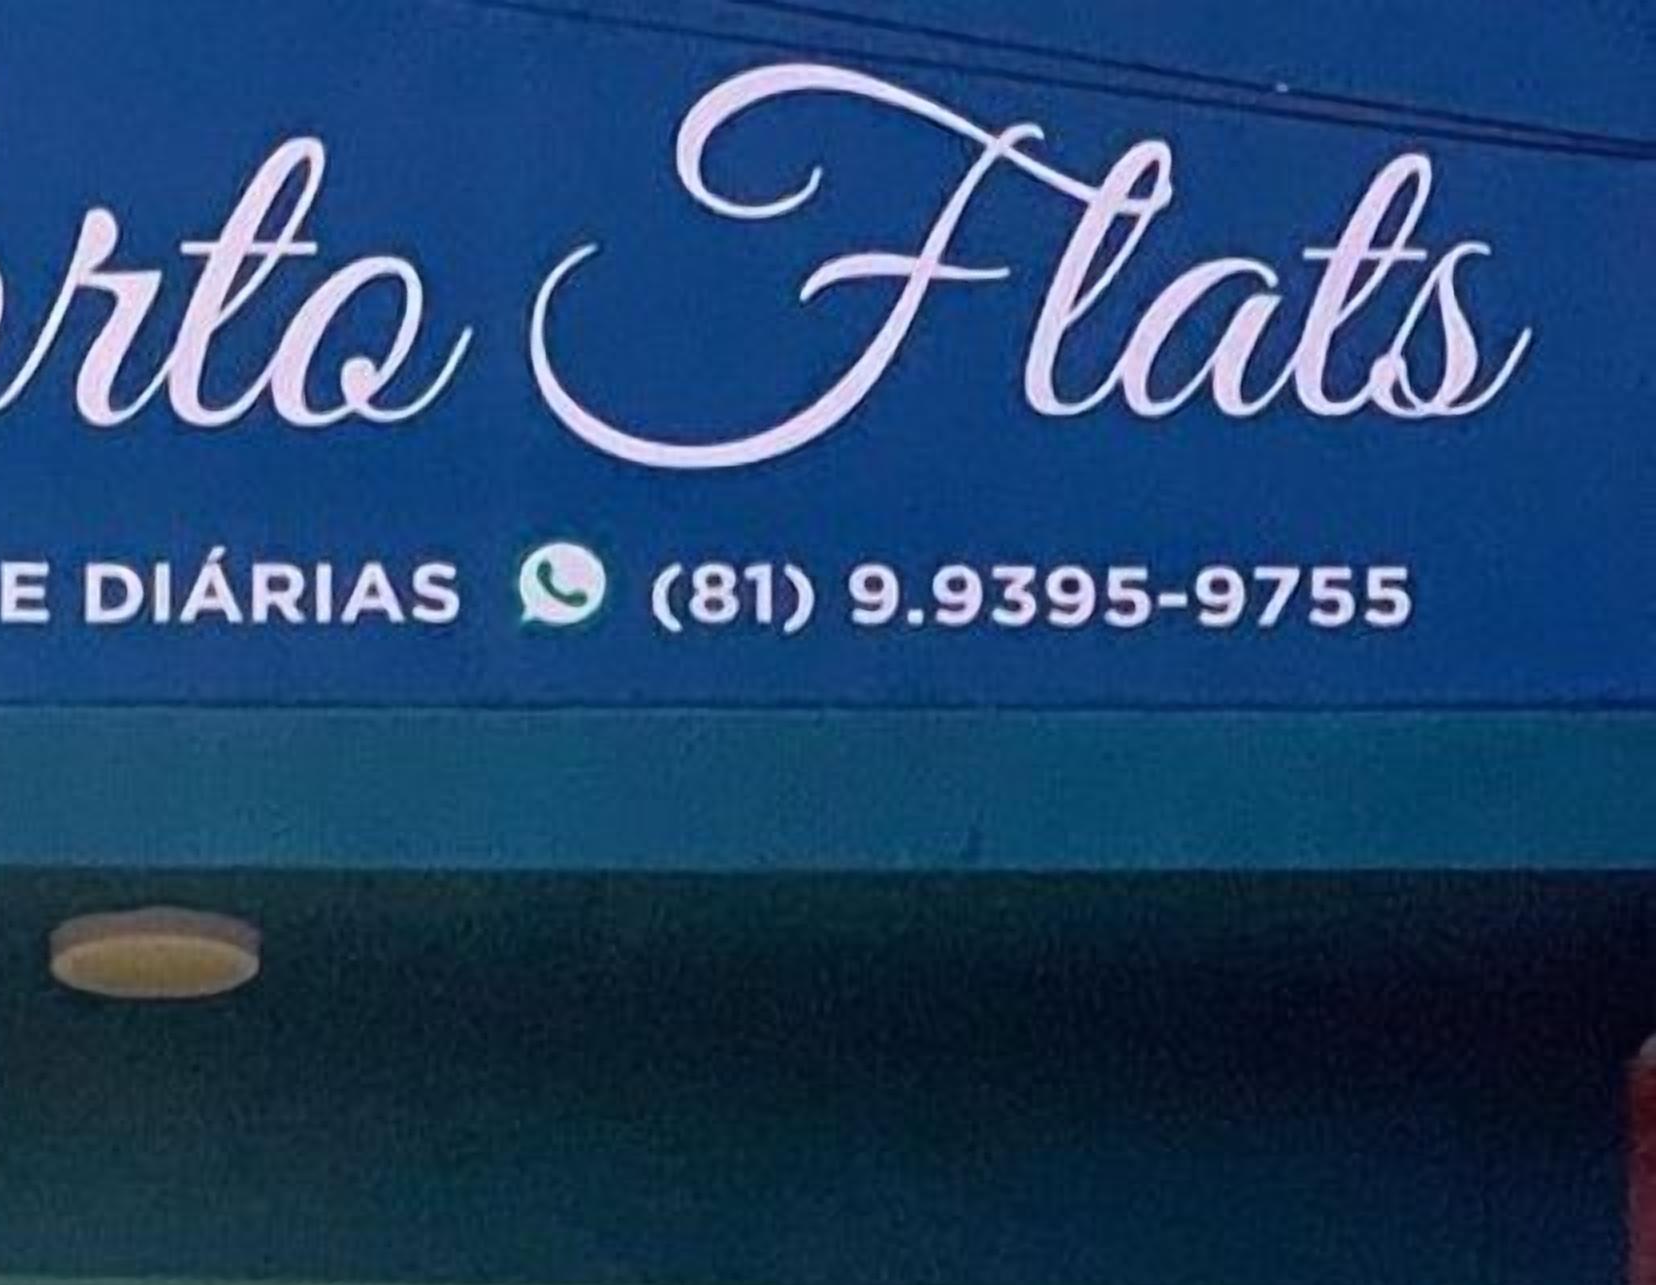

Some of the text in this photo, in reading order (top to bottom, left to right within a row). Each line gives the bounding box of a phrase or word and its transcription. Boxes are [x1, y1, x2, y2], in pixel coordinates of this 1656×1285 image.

[529, 62, 1532, 468] Flats
[84, 546, 460, 626] DIÁRIAS
[650, 561, 816, 634] (81)
[847, 563, 1413, 629] 9.9395-9755
